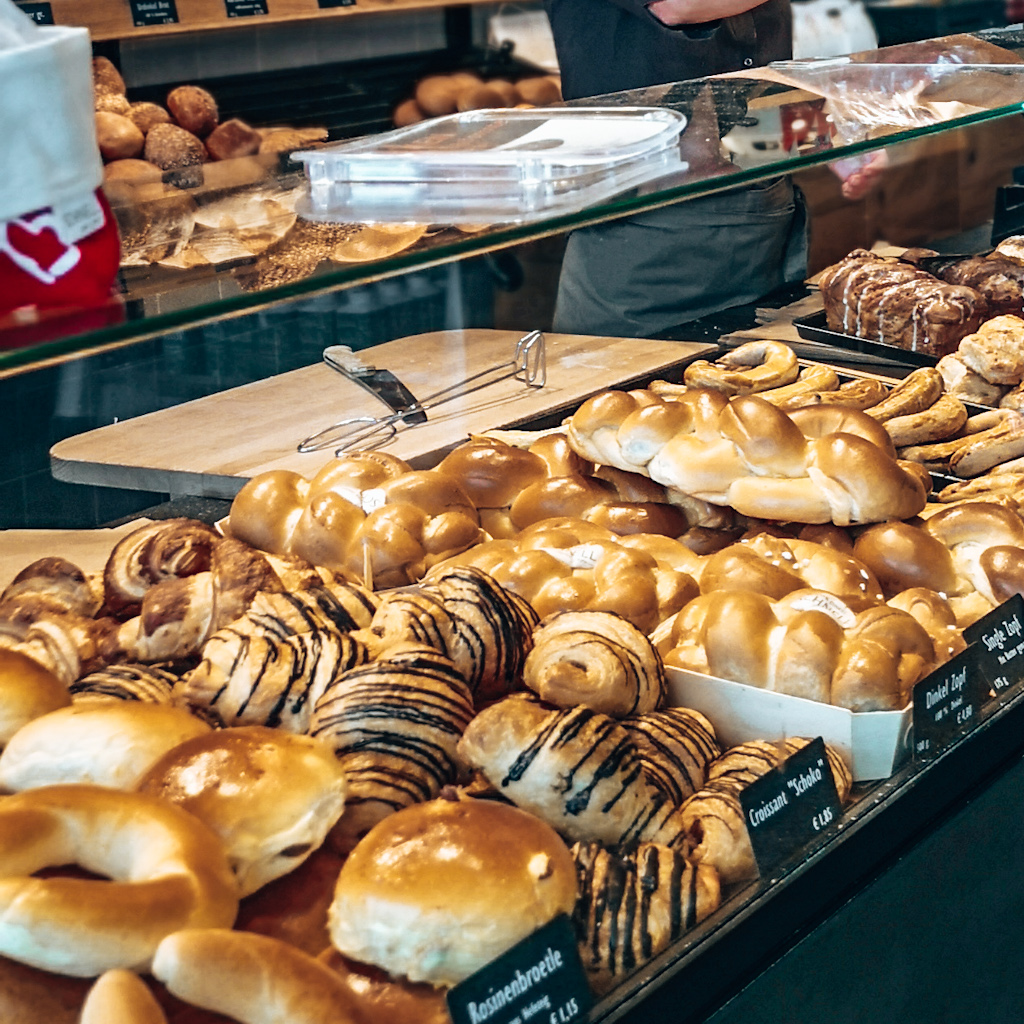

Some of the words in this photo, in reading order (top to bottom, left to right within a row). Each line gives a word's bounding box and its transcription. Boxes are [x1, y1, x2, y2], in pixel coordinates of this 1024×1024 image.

[981, 628, 1007, 651] Single
[1002, 614, 1022, 637] Zopf
[926, 679, 949, 709] Dinkel
[951, 665, 967, 692] Zopf
[749, 791, 788, 827] Croissant
[787, 758, 824, 796] "Schoko"
[468, 947, 562, 1024] Rosinenbroetle
